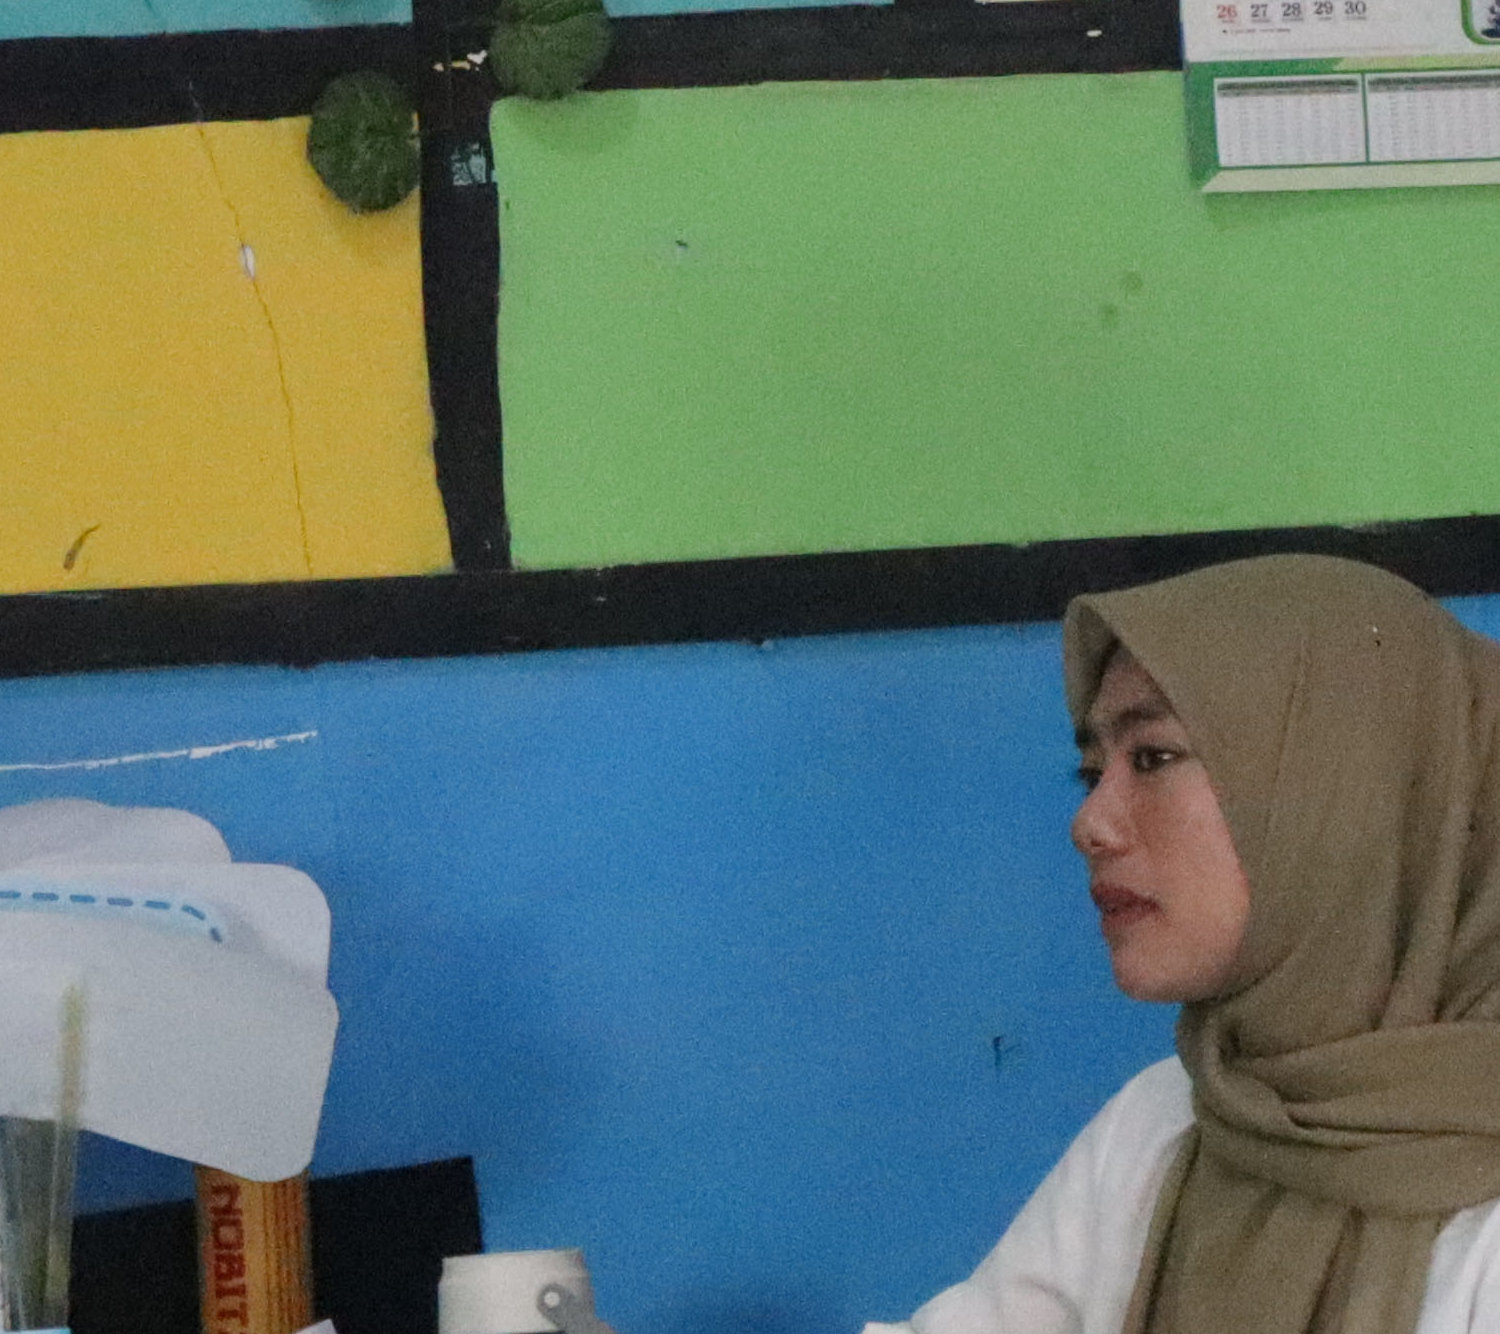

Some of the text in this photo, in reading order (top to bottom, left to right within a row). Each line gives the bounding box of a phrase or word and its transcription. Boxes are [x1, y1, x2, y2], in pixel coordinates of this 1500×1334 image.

[1217, 2, 1366, 18] 26 27 28 29 30
